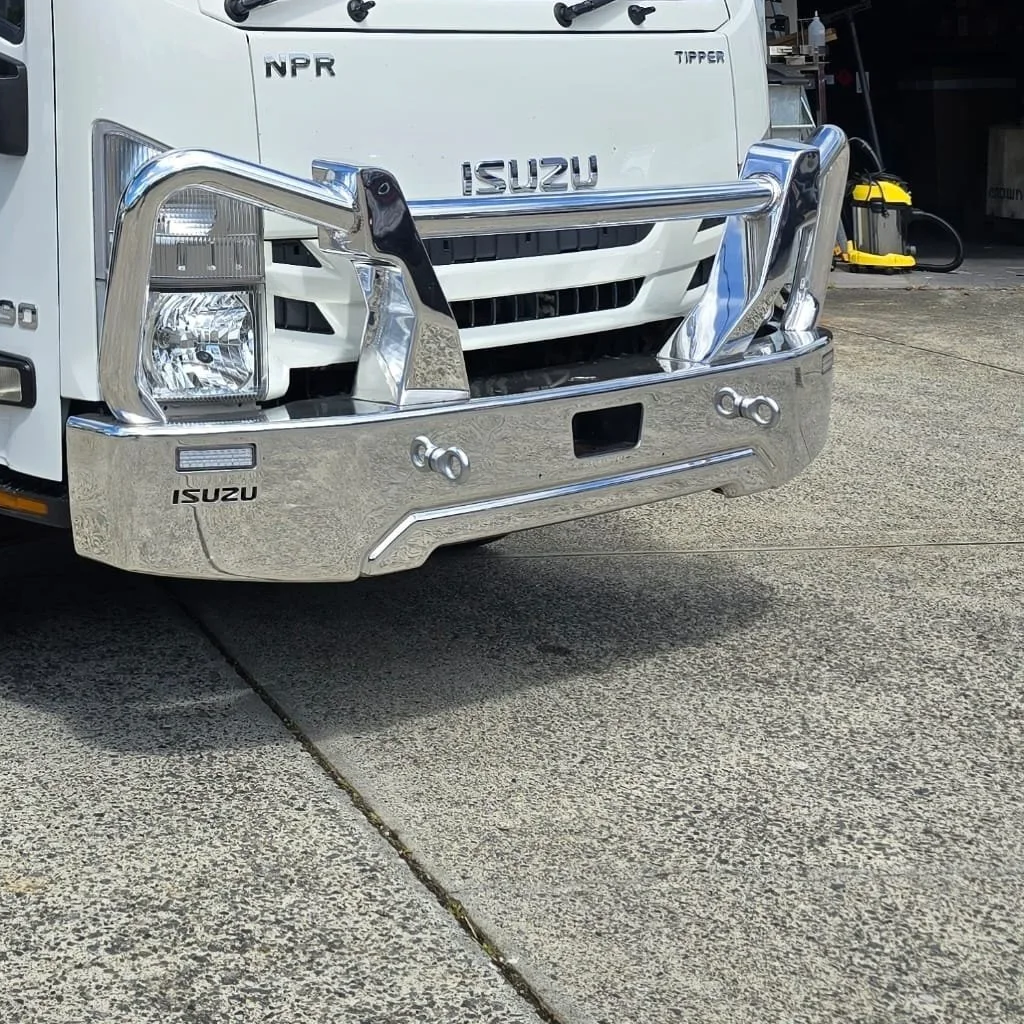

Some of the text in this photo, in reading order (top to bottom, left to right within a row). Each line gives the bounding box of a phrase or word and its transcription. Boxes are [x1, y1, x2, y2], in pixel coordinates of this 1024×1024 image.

[264, 53, 336, 78] NPR
[674, 50, 725, 65] TIPPER
[462, 154, 598, 196] ISUZU
[172, 486, 257, 505] ISUZU
